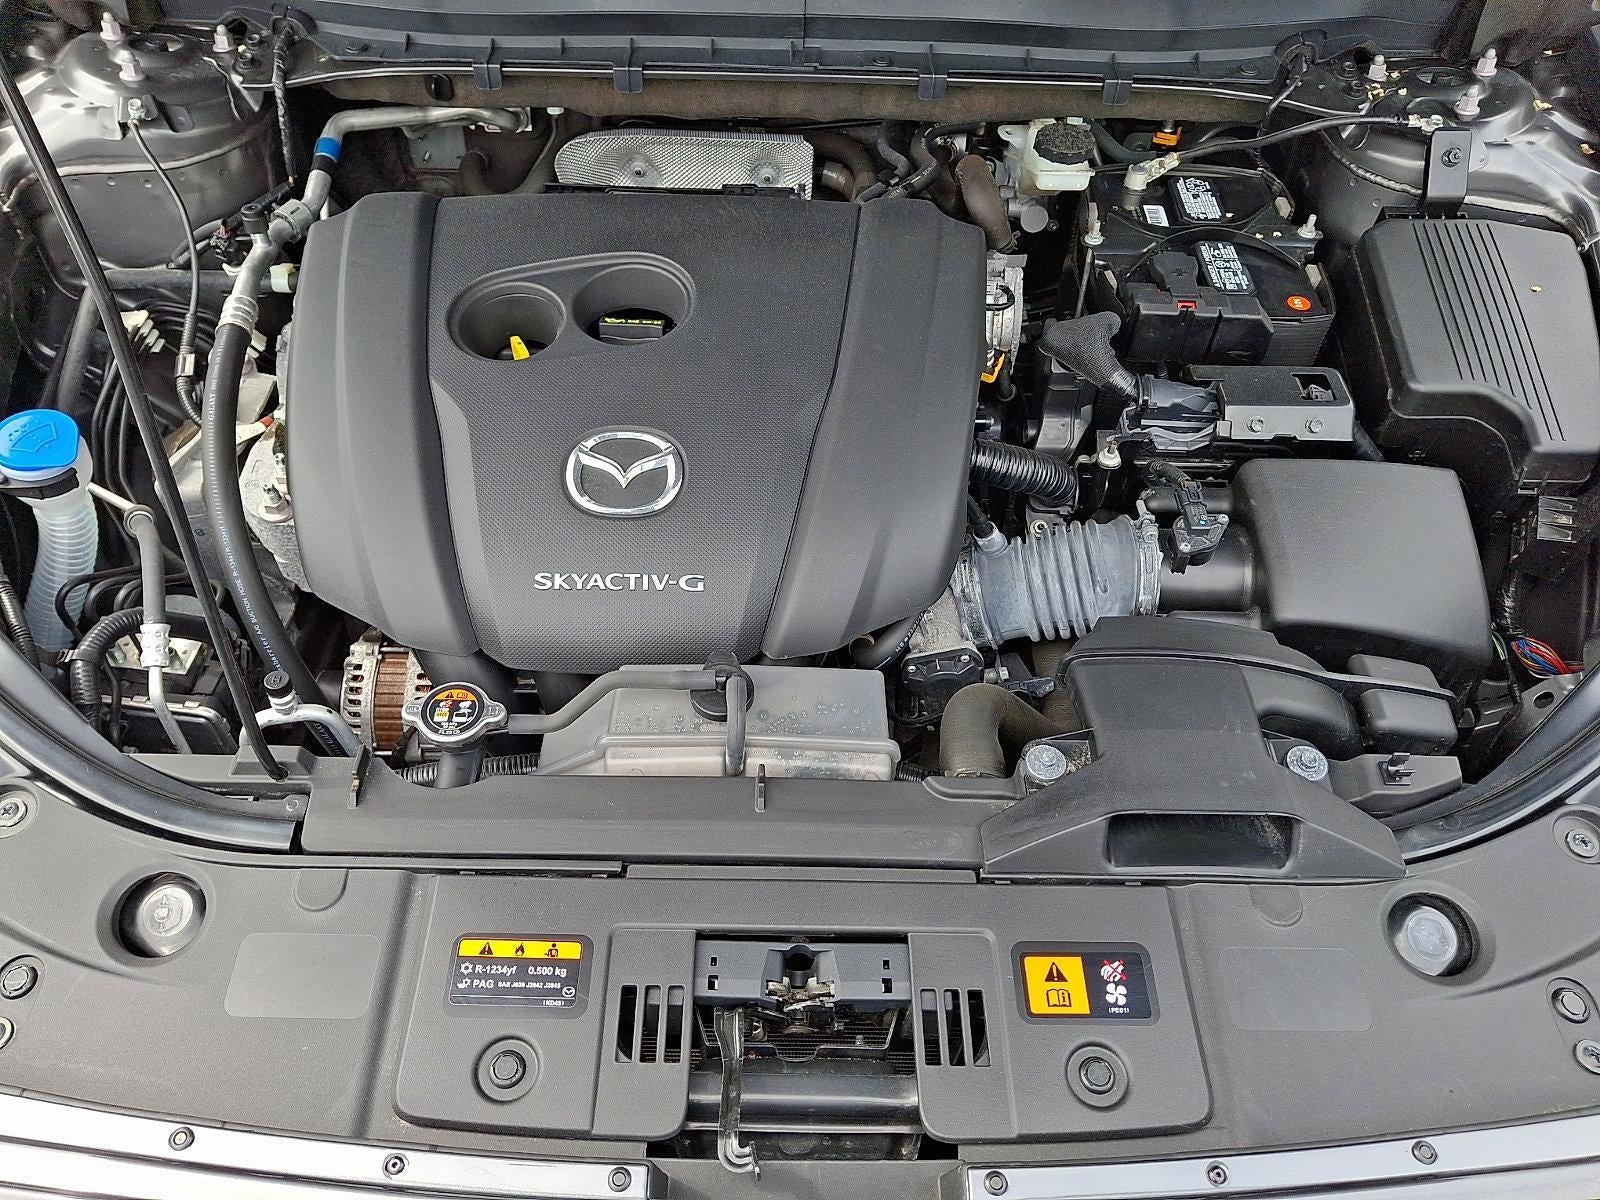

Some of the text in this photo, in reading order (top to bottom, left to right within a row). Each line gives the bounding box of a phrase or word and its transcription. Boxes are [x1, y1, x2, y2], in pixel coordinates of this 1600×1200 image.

[533, 572, 705, 592] SKYACTIV-G
[474, 964, 567, 977] R-1234yf 0.500 kg
[472, 979, 494, 988] PAG
